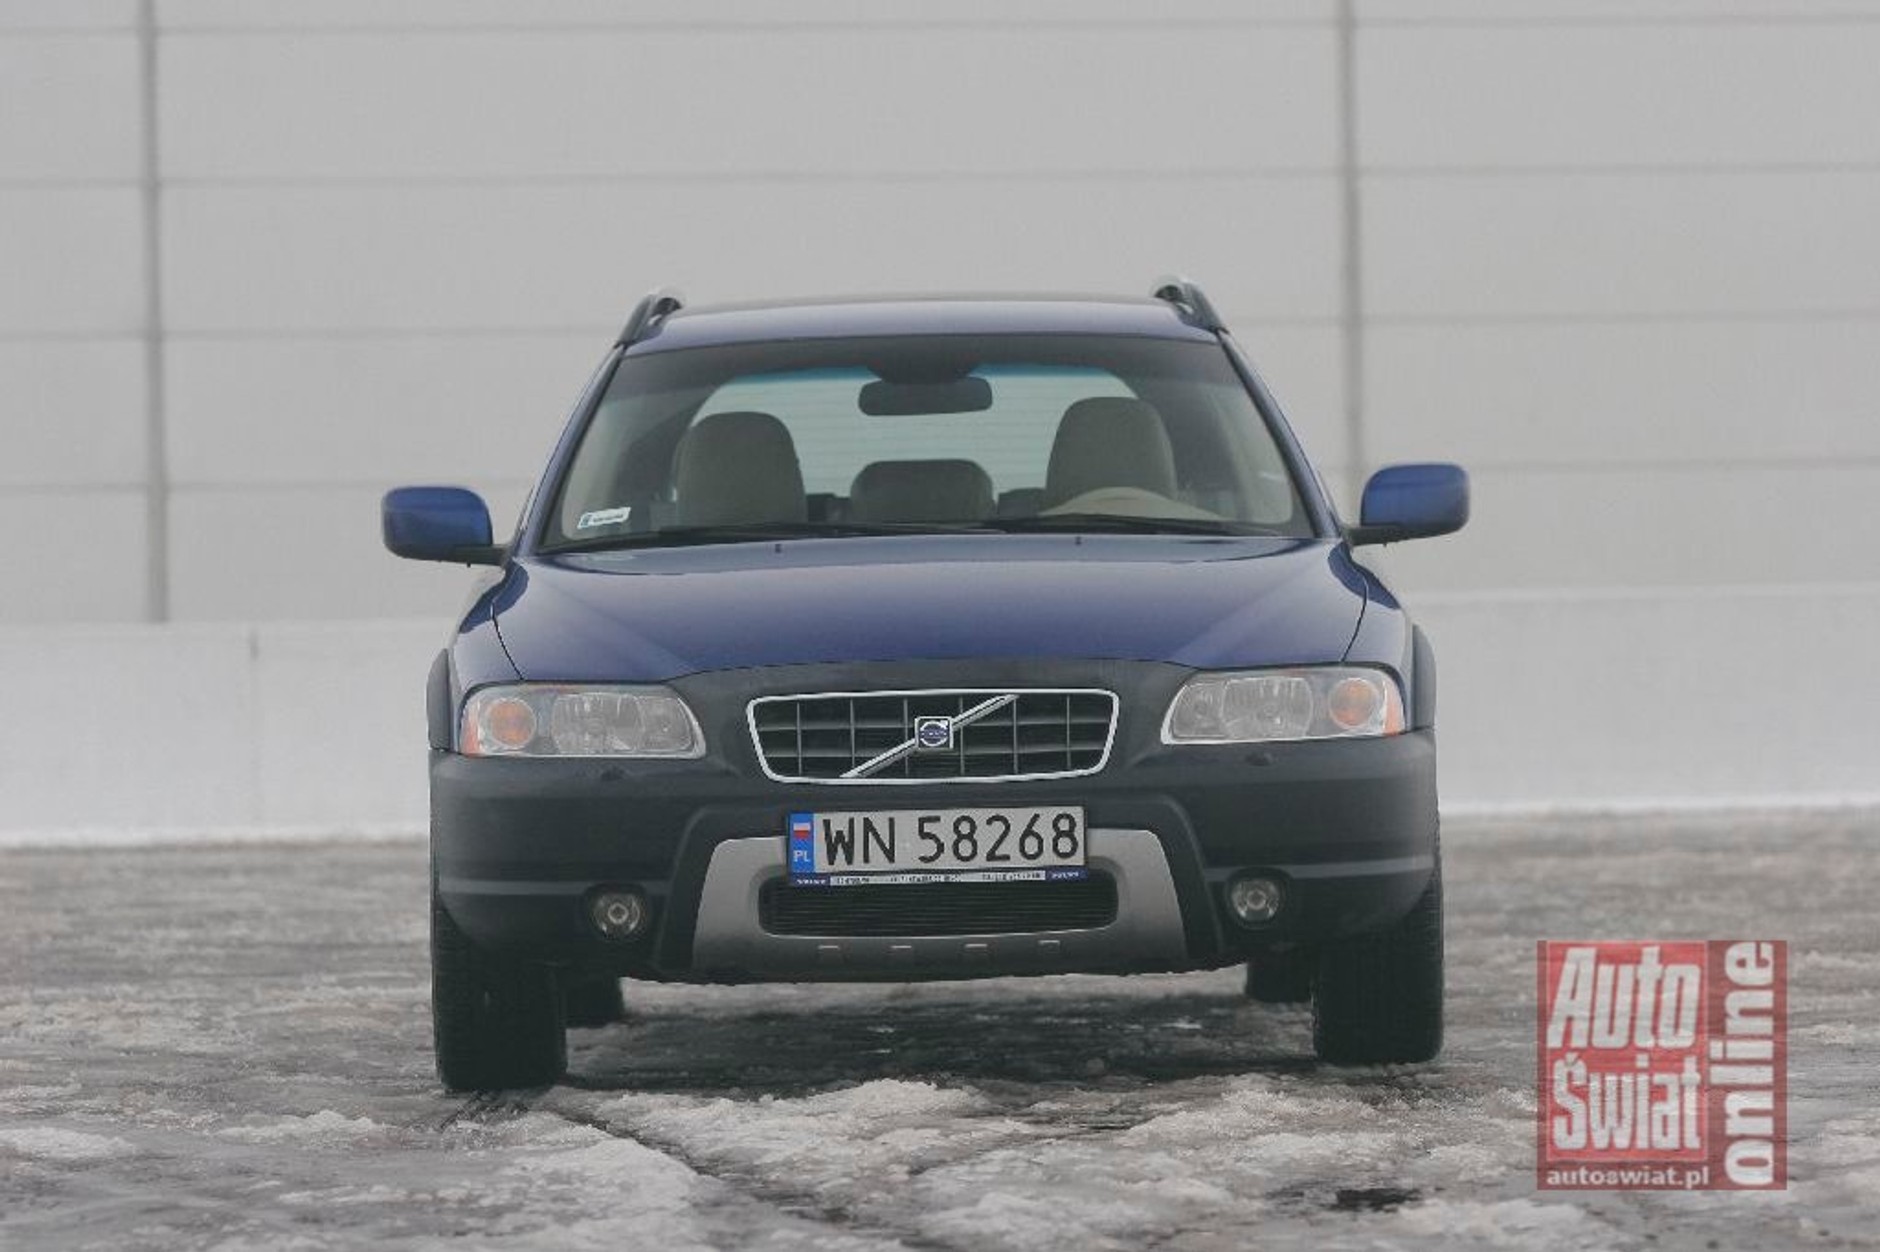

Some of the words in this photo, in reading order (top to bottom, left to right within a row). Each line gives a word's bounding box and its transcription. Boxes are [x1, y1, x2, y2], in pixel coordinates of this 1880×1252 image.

[823, 816, 895, 866] WN
[918, 812, 1079, 863] 58268
[793, 850, 810, 863] PL
